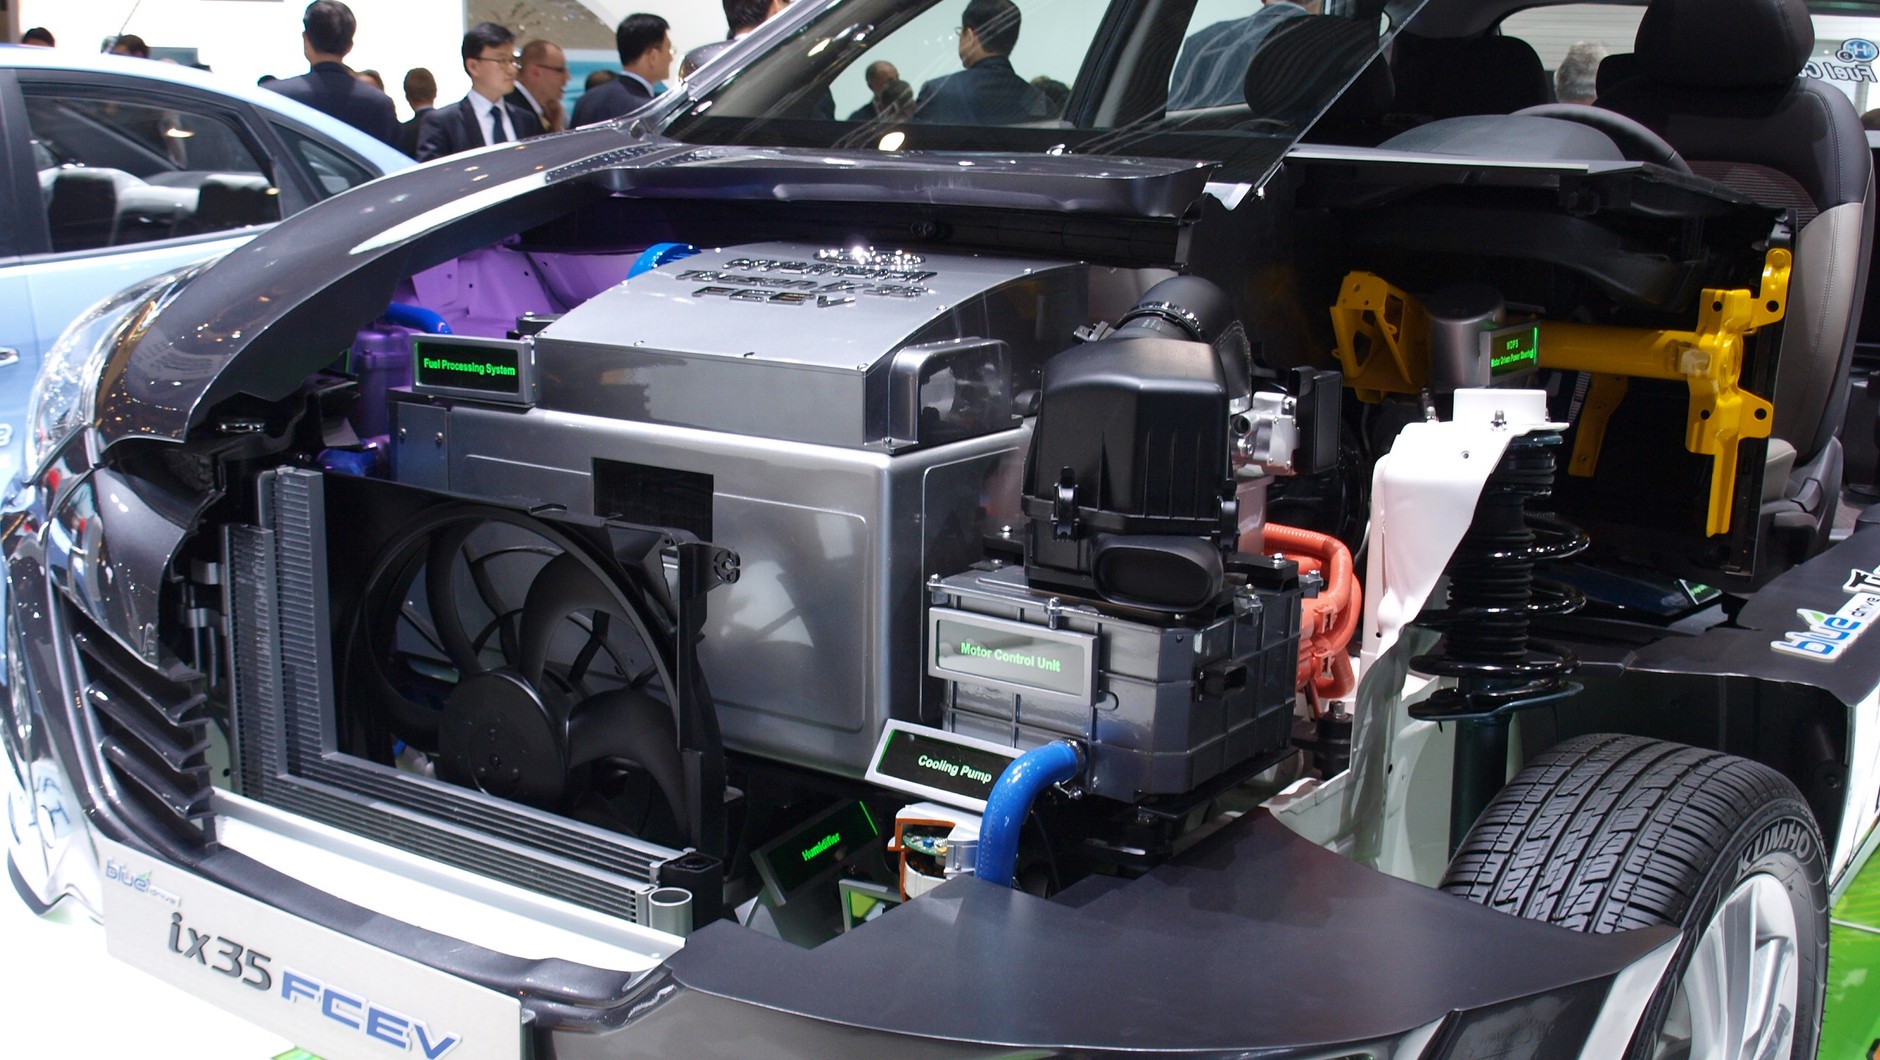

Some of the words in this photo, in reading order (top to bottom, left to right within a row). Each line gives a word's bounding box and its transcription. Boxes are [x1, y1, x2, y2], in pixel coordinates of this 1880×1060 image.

[423, 358, 441, 369] Fuel
[441, 359, 485, 375] Processing
[485, 363, 516, 376] System
[1778, 616, 1862, 656] blue
[960, 642, 992, 659] Motor
[994, 648, 1035, 667] Control
[1037, 657, 1061, 672] Unit
[917, 754, 960, 777] Cooling
[960, 765, 993, 784] Pump
[801, 832, 841, 861] Humidifier
[1736, 821, 1811, 882] KUMHO
[105, 859, 148, 893] blue
[168, 911, 272, 992] ix35
[281, 969, 460, 1060] FCEV
